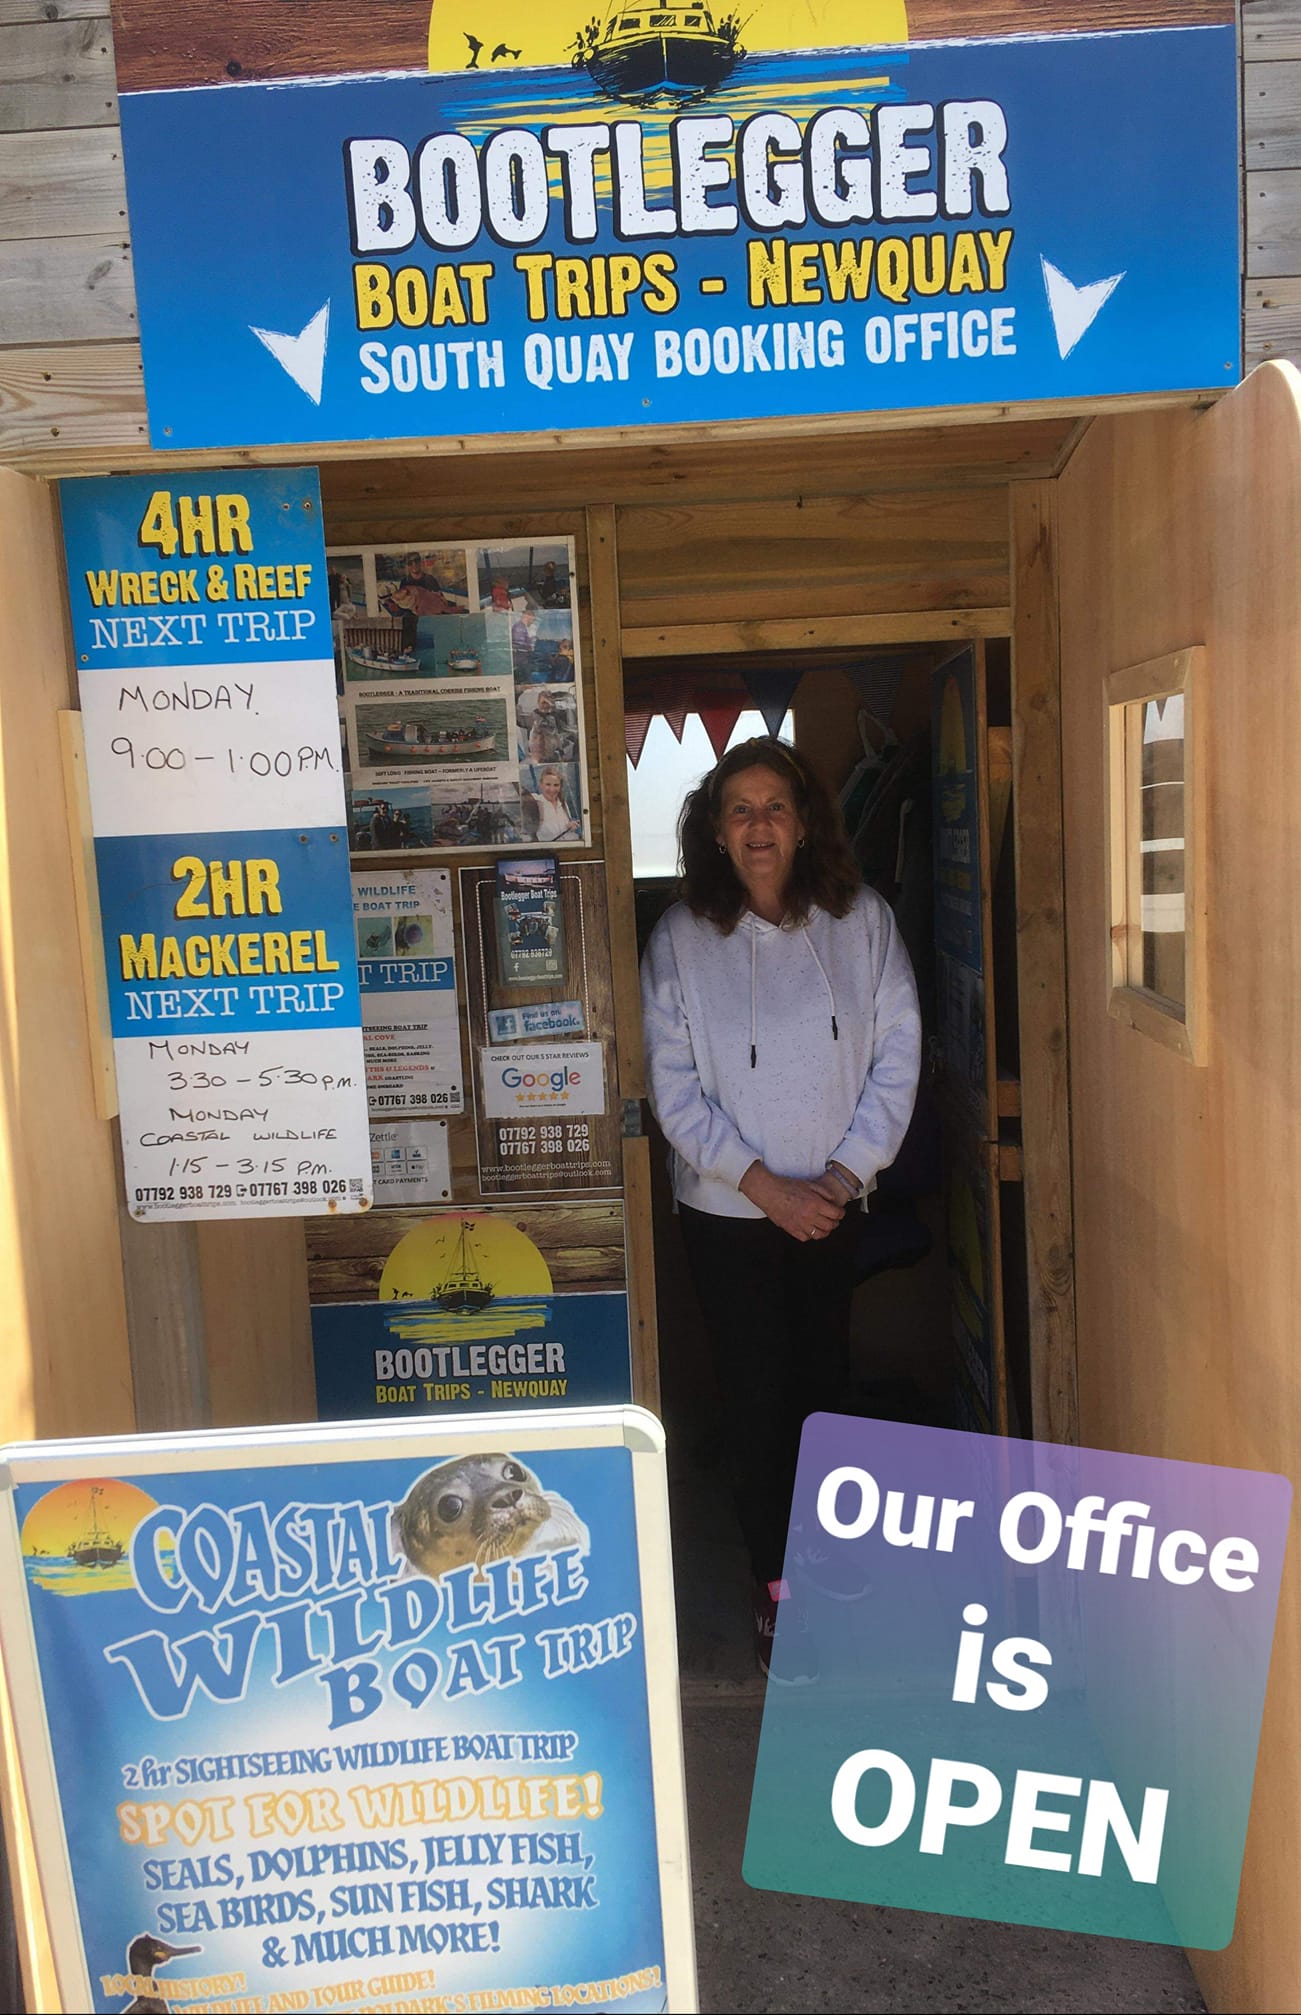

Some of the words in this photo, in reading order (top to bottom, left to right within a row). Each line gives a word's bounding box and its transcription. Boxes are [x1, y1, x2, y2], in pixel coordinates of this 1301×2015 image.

[345, 99, 1011, 256] BOOTLEGGER
[353, 261, 494, 331] BOAT
[515, 252, 679, 321] TRIPS
[701, 275, 727, 295] -
[747, 228, 1014, 308] NEWQUAY
[359, 340, 505, 393] SOUTH
[524, 332, 634, 390] QUAY
[655, 319, 844, 378] BOOKING
[865, 307, 1018, 364] OFFICE
[138, 490, 254, 558] 4HR
[86, 569, 201, 607] WRECK
[206, 565, 230, 602] &
[234, 563, 313, 600] REEF
[90, 613, 207, 650] NEXT
[218, 609, 316, 644] TRIP
[172, 855, 283, 921] 2HR
[357, 885, 416, 897] WILDLIFE
[363, 900, 392, 911] BOAT
[395, 899, 420, 910] TRIP
[500, 890, 531, 902] Bootlegger
[531, 889, 543, 900] Boat
[544, 888, 557, 899] Trips
[119, 930, 340, 981] MACKEREL
[380, 961, 448, 985] TRIP
[125, 986, 241, 1021] NEXT
[249, 982, 345, 1015] TRIP
[148, 1040, 250, 1060] MONDAY
[501, 1066, 582, 1092] Google
[169, 1107, 269, 1122] MONDAY
[378, 1095, 406, 1106] 07767
[410, 1094, 427, 1105] 398
[431, 1093, 448, 1104] 026
[140, 1129, 231, 1147] COASTAL
[253, 1128, 338, 1141] WILDLIFE
[370, 1132, 397, 1143] Zettle
[499, 1127, 536, 1141] 07792
[540, 1125, 563, 1139] 938
[566, 1124, 589, 1138] 729
[500, 1142, 536, 1156] 07767
[540, 1140, 563, 1154] 398
[567, 1138, 590, 1152] 026
[135, 1187, 175, 1202] 07792
[179, 1186, 204, 1199] 938
[208, 1185, 232, 1198] 729
[249, 1182, 289, 1197] 07767
[293, 1181, 320, 1194] 398
[322, 1180, 346, 1194] 026
[395, 1177, 428, 1185] PAYMENTS
[375, 1342, 566, 1381] BOOTLEGGER
[376, 1384, 416, 1403] BOAT
[424, 1381, 470, 1401] TRIPS
[491, 1379, 567, 1399] NEWQUAY
[130, 1500, 408, 1615] COASTAL
[104, 1546, 590, 1722] WILDLIFE
[320, 1634, 529, 1731] BOAT
[541, 1611, 638, 1681] TRIP
[174, 1746, 333, 1785] SIGHTSEEING
[333, 1737, 450, 1772] WILDLIFE
[453, 1732, 517, 1763] BOAT
[518, 1731, 578, 1761] TRIP
[117, 1792, 237, 1848] SPOT
[248, 1785, 346, 1838] FOR
[348, 1773, 605, 1831] WILDLIFE!
[143, 1855, 245, 1891] SEALS,
[250, 1837, 418, 1881] DOLPHINS,
[421, 1836, 506, 1870] JELLY
[507, 1830, 595, 1868] FISH,
[156, 1898, 224, 1935] SEA
[224, 1890, 325, 1927] BIRDS,
[329, 1883, 400, 1918] SUN
[401, 1879, 482, 1916] FISH,
[487, 1874, 599, 1910] SHARK
[262, 1936, 290, 1968] &
[293, 1926, 398, 1965] MUCH
[399, 1919, 502, 1957] MORE!
[100, 1973, 158, 1999] LOCAL
[158, 1971, 248, 2000] HISTORY!
[263, 1989, 311, 2013] AND
[313, 1978, 365, 2008] TOUR
[367, 1969, 436, 1998] GUIDE!
[467, 1988, 551, 2012] FILMING
[551, 1966, 662, 2008] LOCATIONS!
